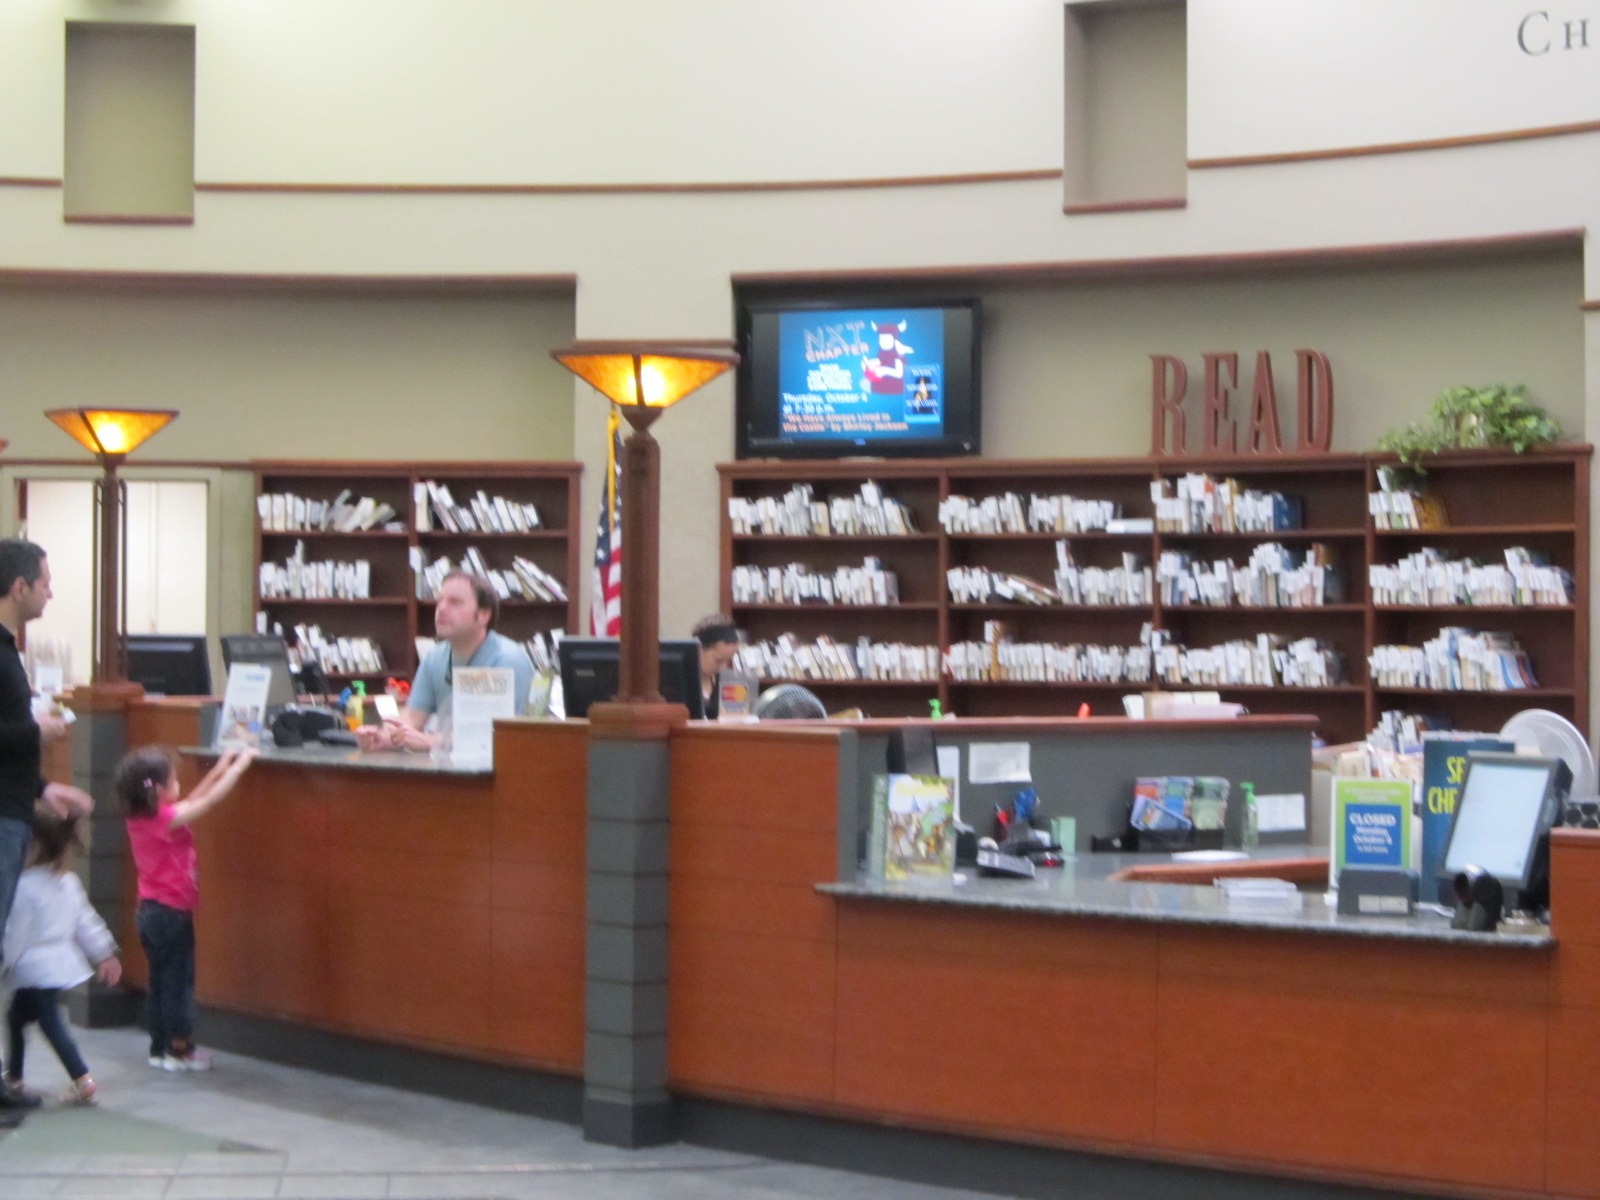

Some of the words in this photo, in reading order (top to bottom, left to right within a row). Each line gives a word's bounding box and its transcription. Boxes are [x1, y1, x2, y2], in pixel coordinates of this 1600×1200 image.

[803, 321, 866, 354] NXT
[806, 342, 869, 363] CHAPTER
[1148, 348, 1334, 456] READ
[1349, 813, 1396, 826] CLOSED
